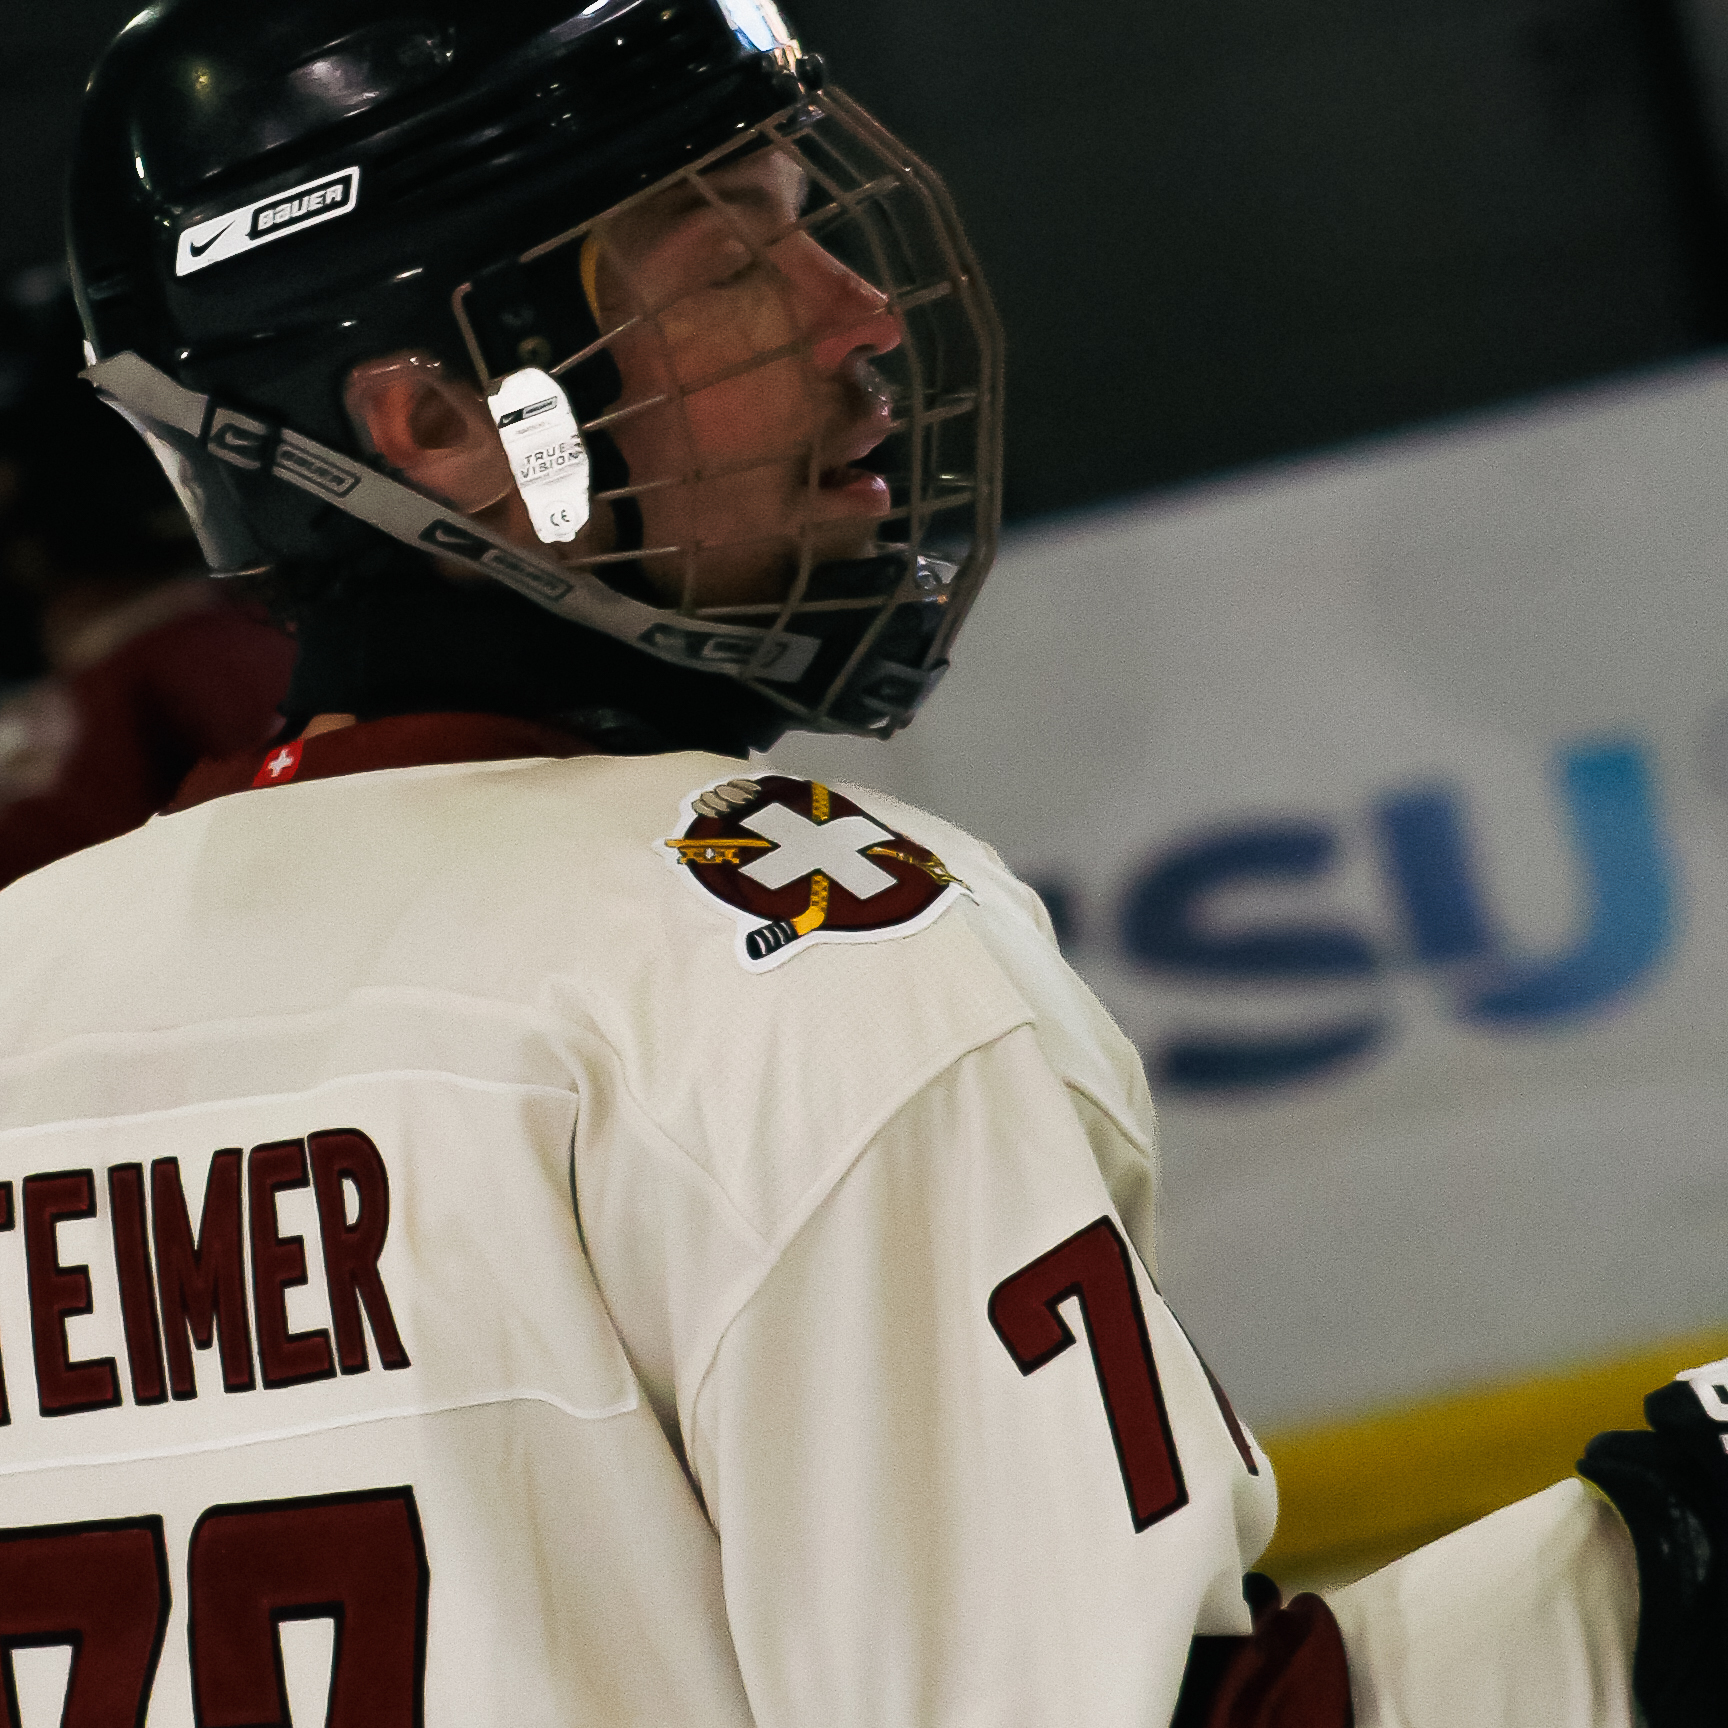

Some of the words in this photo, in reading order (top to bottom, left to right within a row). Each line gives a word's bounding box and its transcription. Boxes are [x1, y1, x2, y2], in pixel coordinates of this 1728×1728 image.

[257, 183, 344, 231] BAUER
[524, 442, 566, 466] TRUE
[987, 1214, 1260, 1534] 7
